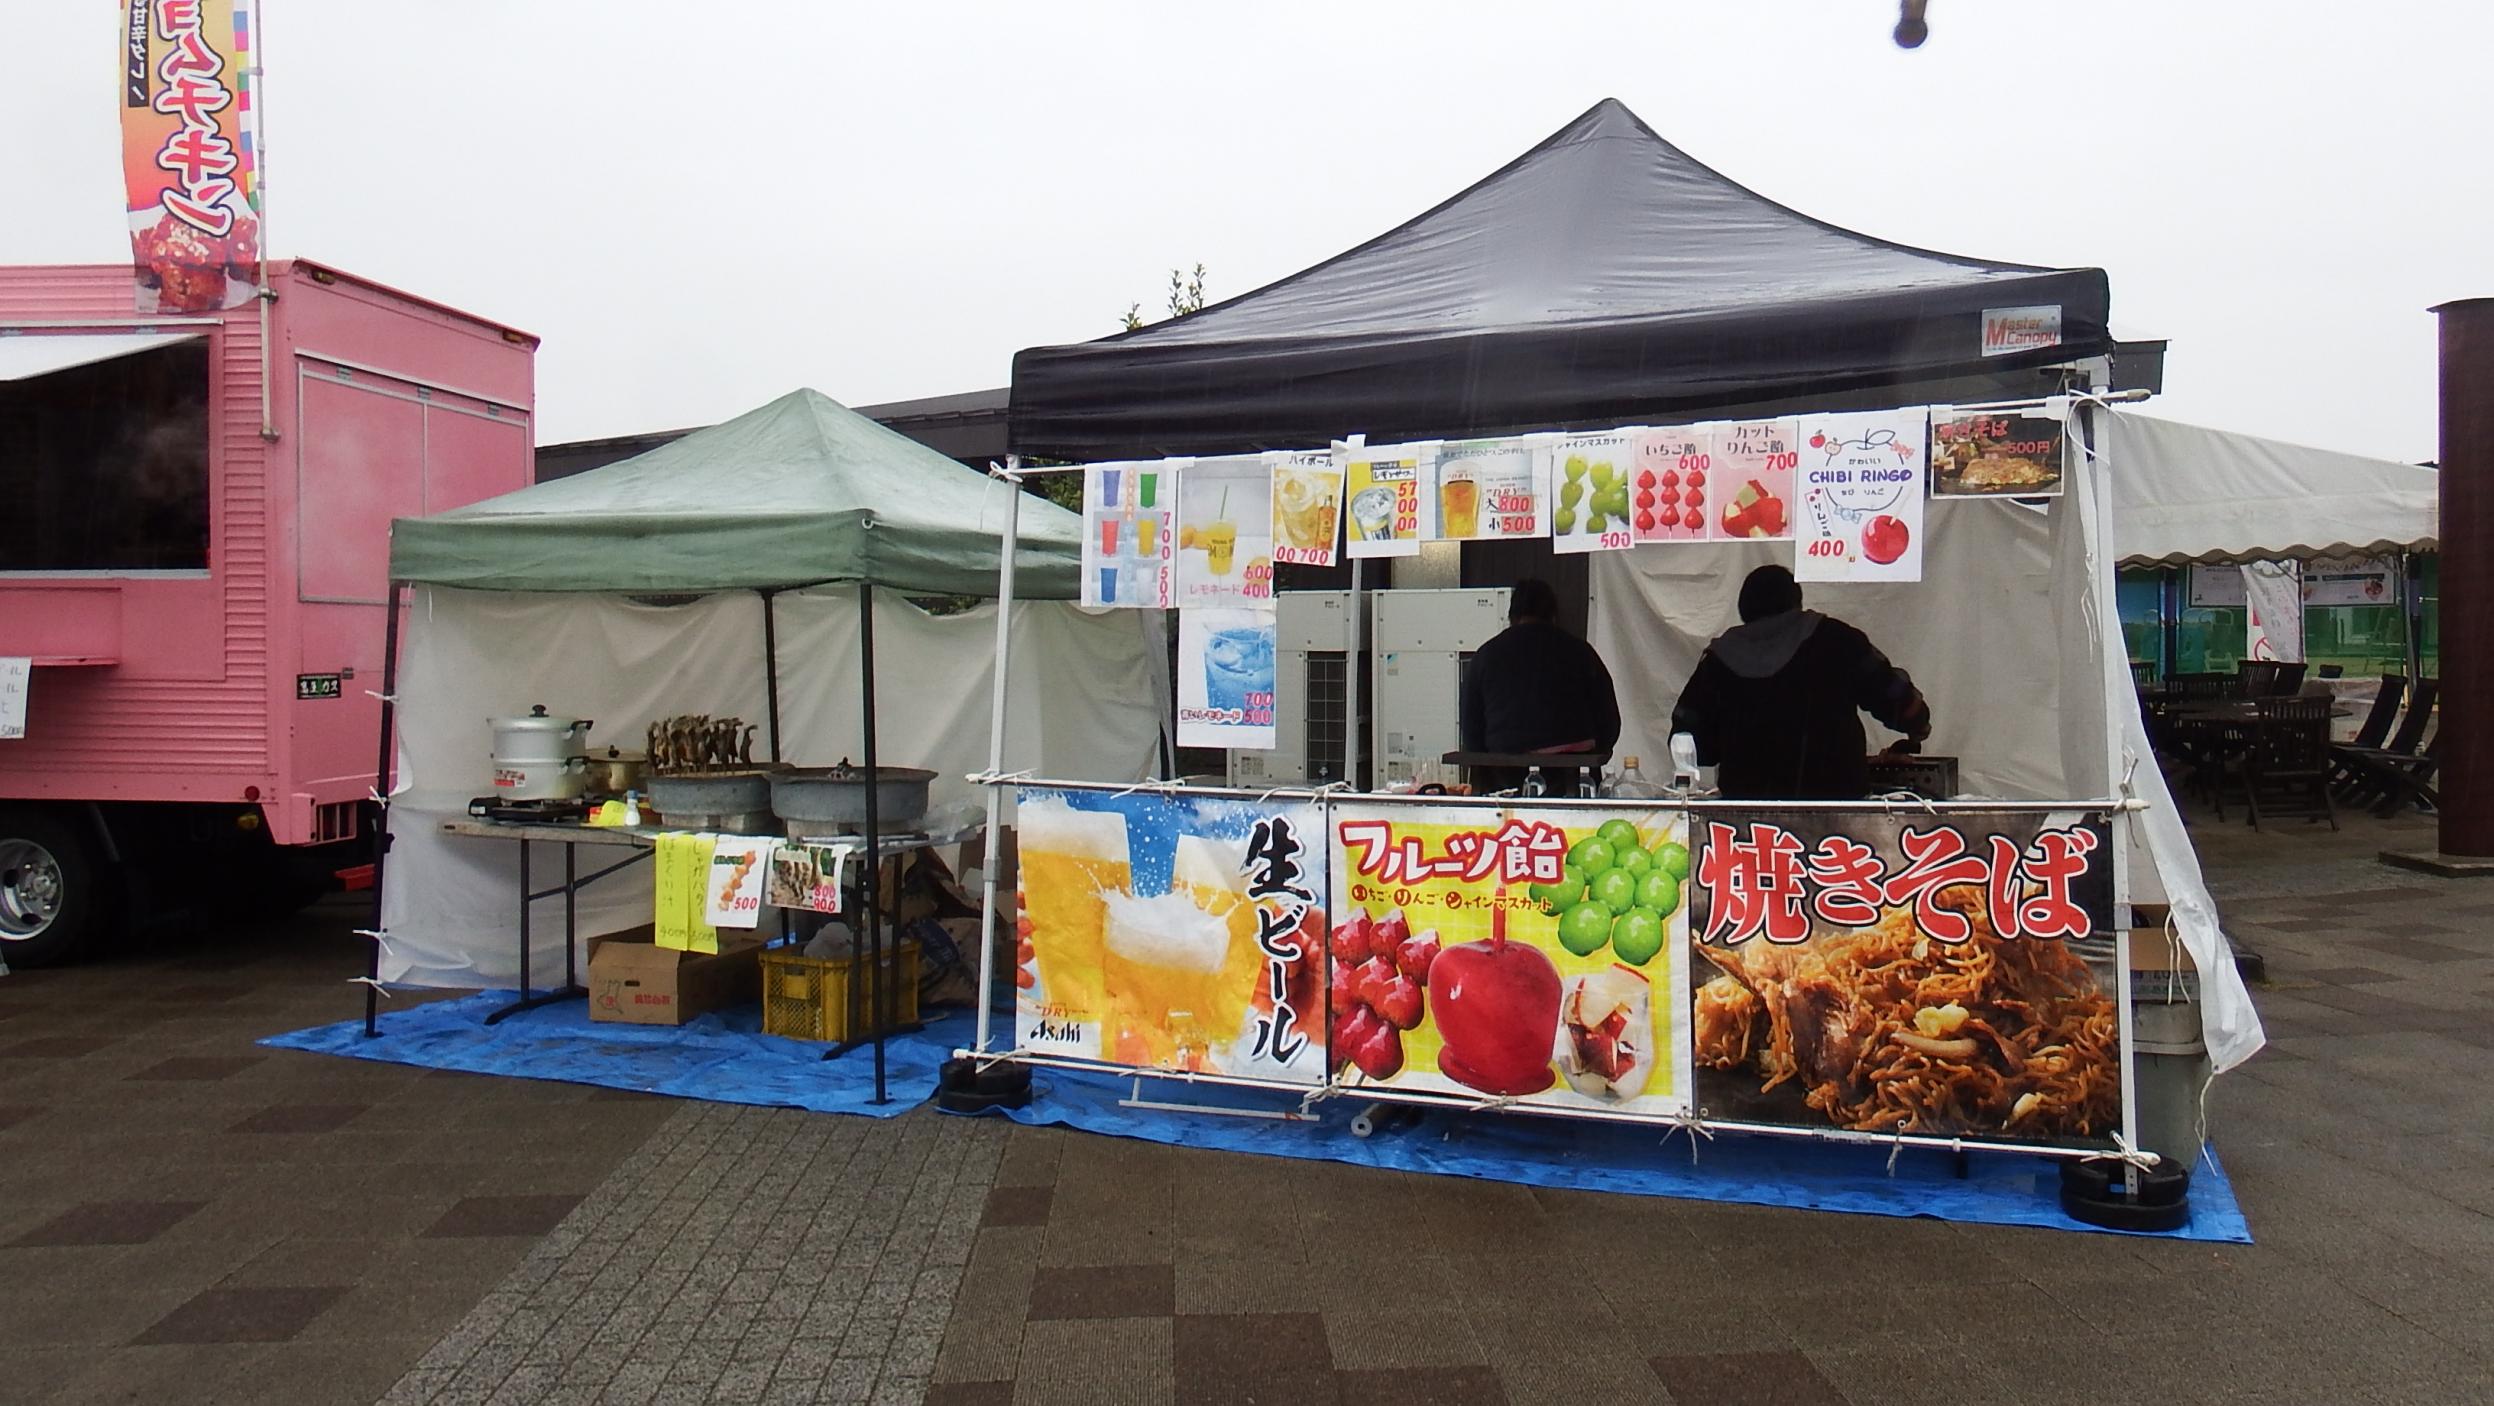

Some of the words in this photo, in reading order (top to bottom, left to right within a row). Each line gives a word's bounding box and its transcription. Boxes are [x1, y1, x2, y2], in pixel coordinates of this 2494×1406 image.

[1985, 316, 2042, 346] Master
[2006, 331, 2057, 348] Canopy
[1736, 425, 1775, 438] カット
[2007, 441, 2050, 454] 500円
[1288, 455, 1334, 468] ハイボール
[1679, 454, 1710, 471] 600
[1767, 451, 1797, 470] 700
[1809, 470, 1852, 483] CHIBI
[1861, 469, 1913, 482] RINGO
[1499, 496, 1530, 512] 800
[1502, 516, 1535, 532] 500
[1161, 511, 1171, 561] 700
[1600, 532, 1632, 550] 500
[1299, 549, 1330, 564] 700
[1808, 540, 1845, 557] 400
[1244, 565, 1273, 581] 600
[1189, 583, 1241, 596] レモネード
[1243, 583, 1270, 599] 400
[1244, 692, 1274, 707] 700
[1244, 709, 1272, 724] 500
[1340, 820, 1569, 885] フルーツ飴
[1699, 822, 2099, 943] 焼きそば
[814, 884, 836, 899] 800
[734, 897, 758, 911] 500
[813, 899, 836, 913] 900
[1240, 815, 1315, 1066] 生ビール
[1030, 1019, 1081, 1043] Asahi
